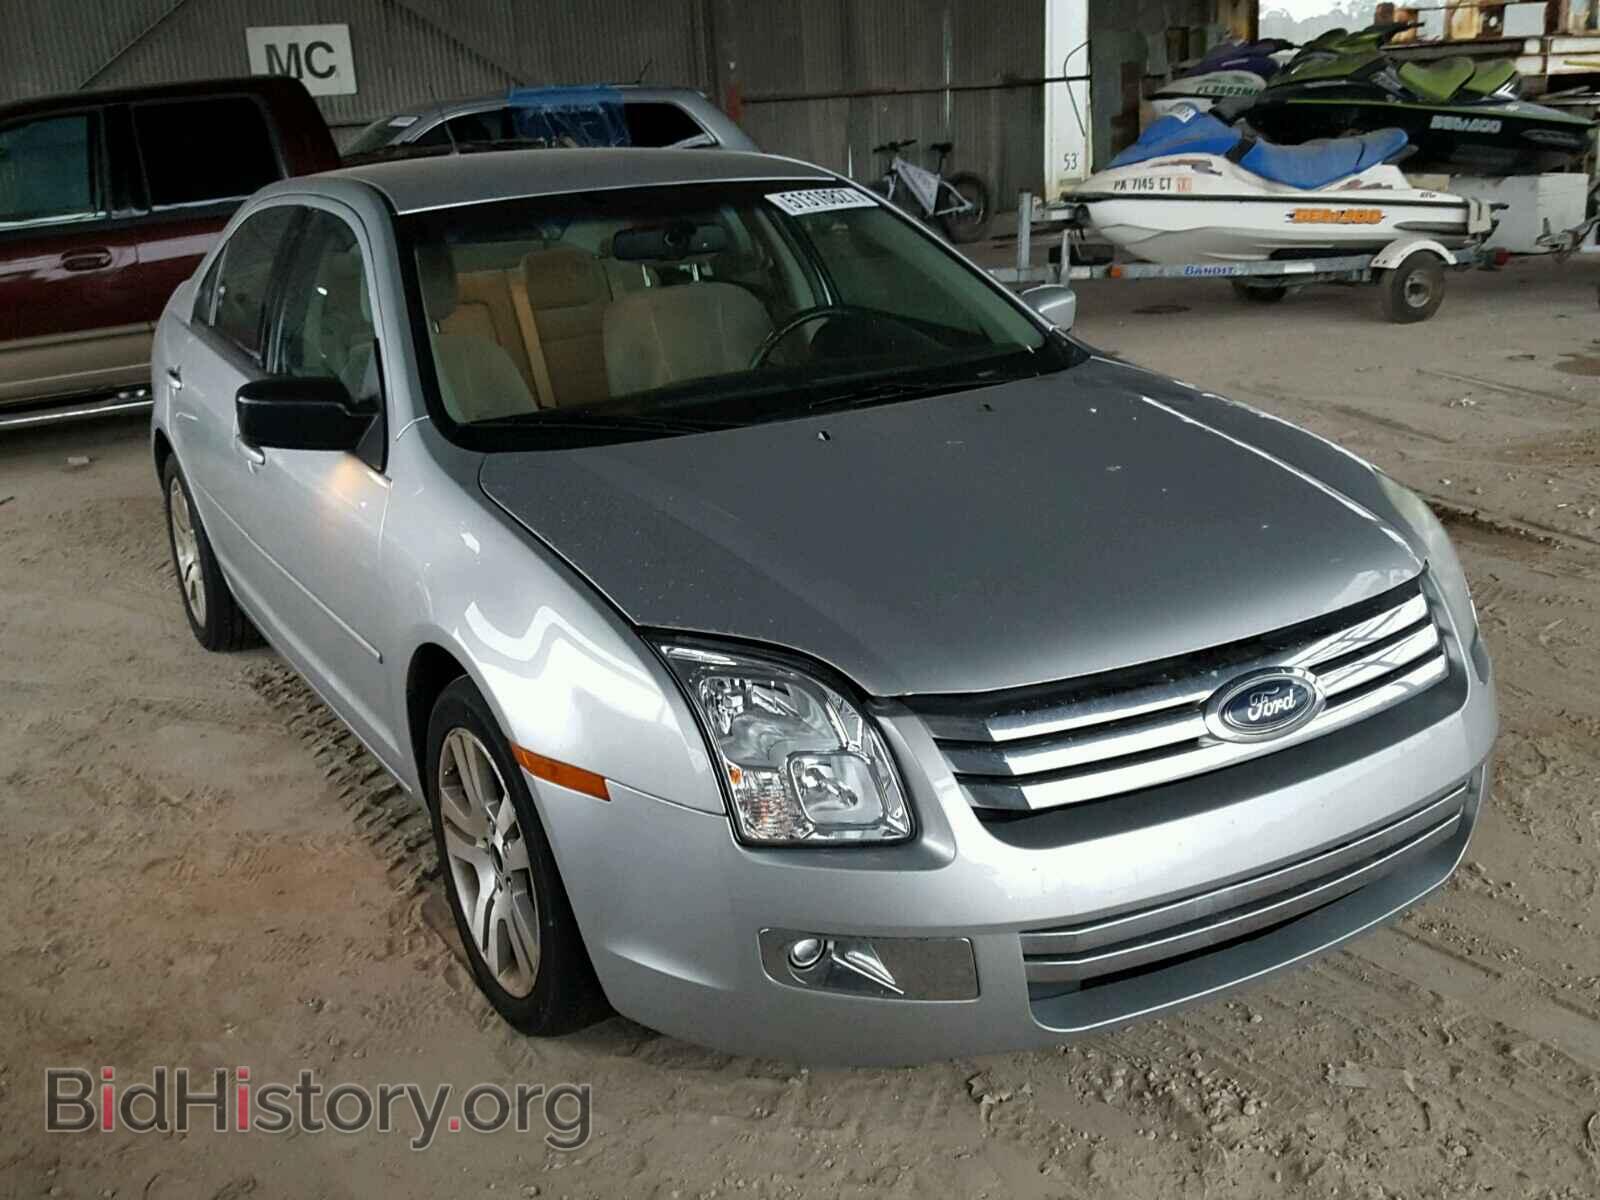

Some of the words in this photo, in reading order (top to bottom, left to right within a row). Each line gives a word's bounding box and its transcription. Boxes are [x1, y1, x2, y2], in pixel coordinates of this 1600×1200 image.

[264, 40, 337, 80] MC
[1132, 176, 1155, 191] 7145
[1159, 176, 1172, 191] CT
[1247, 686, 1296, 722] Ford
